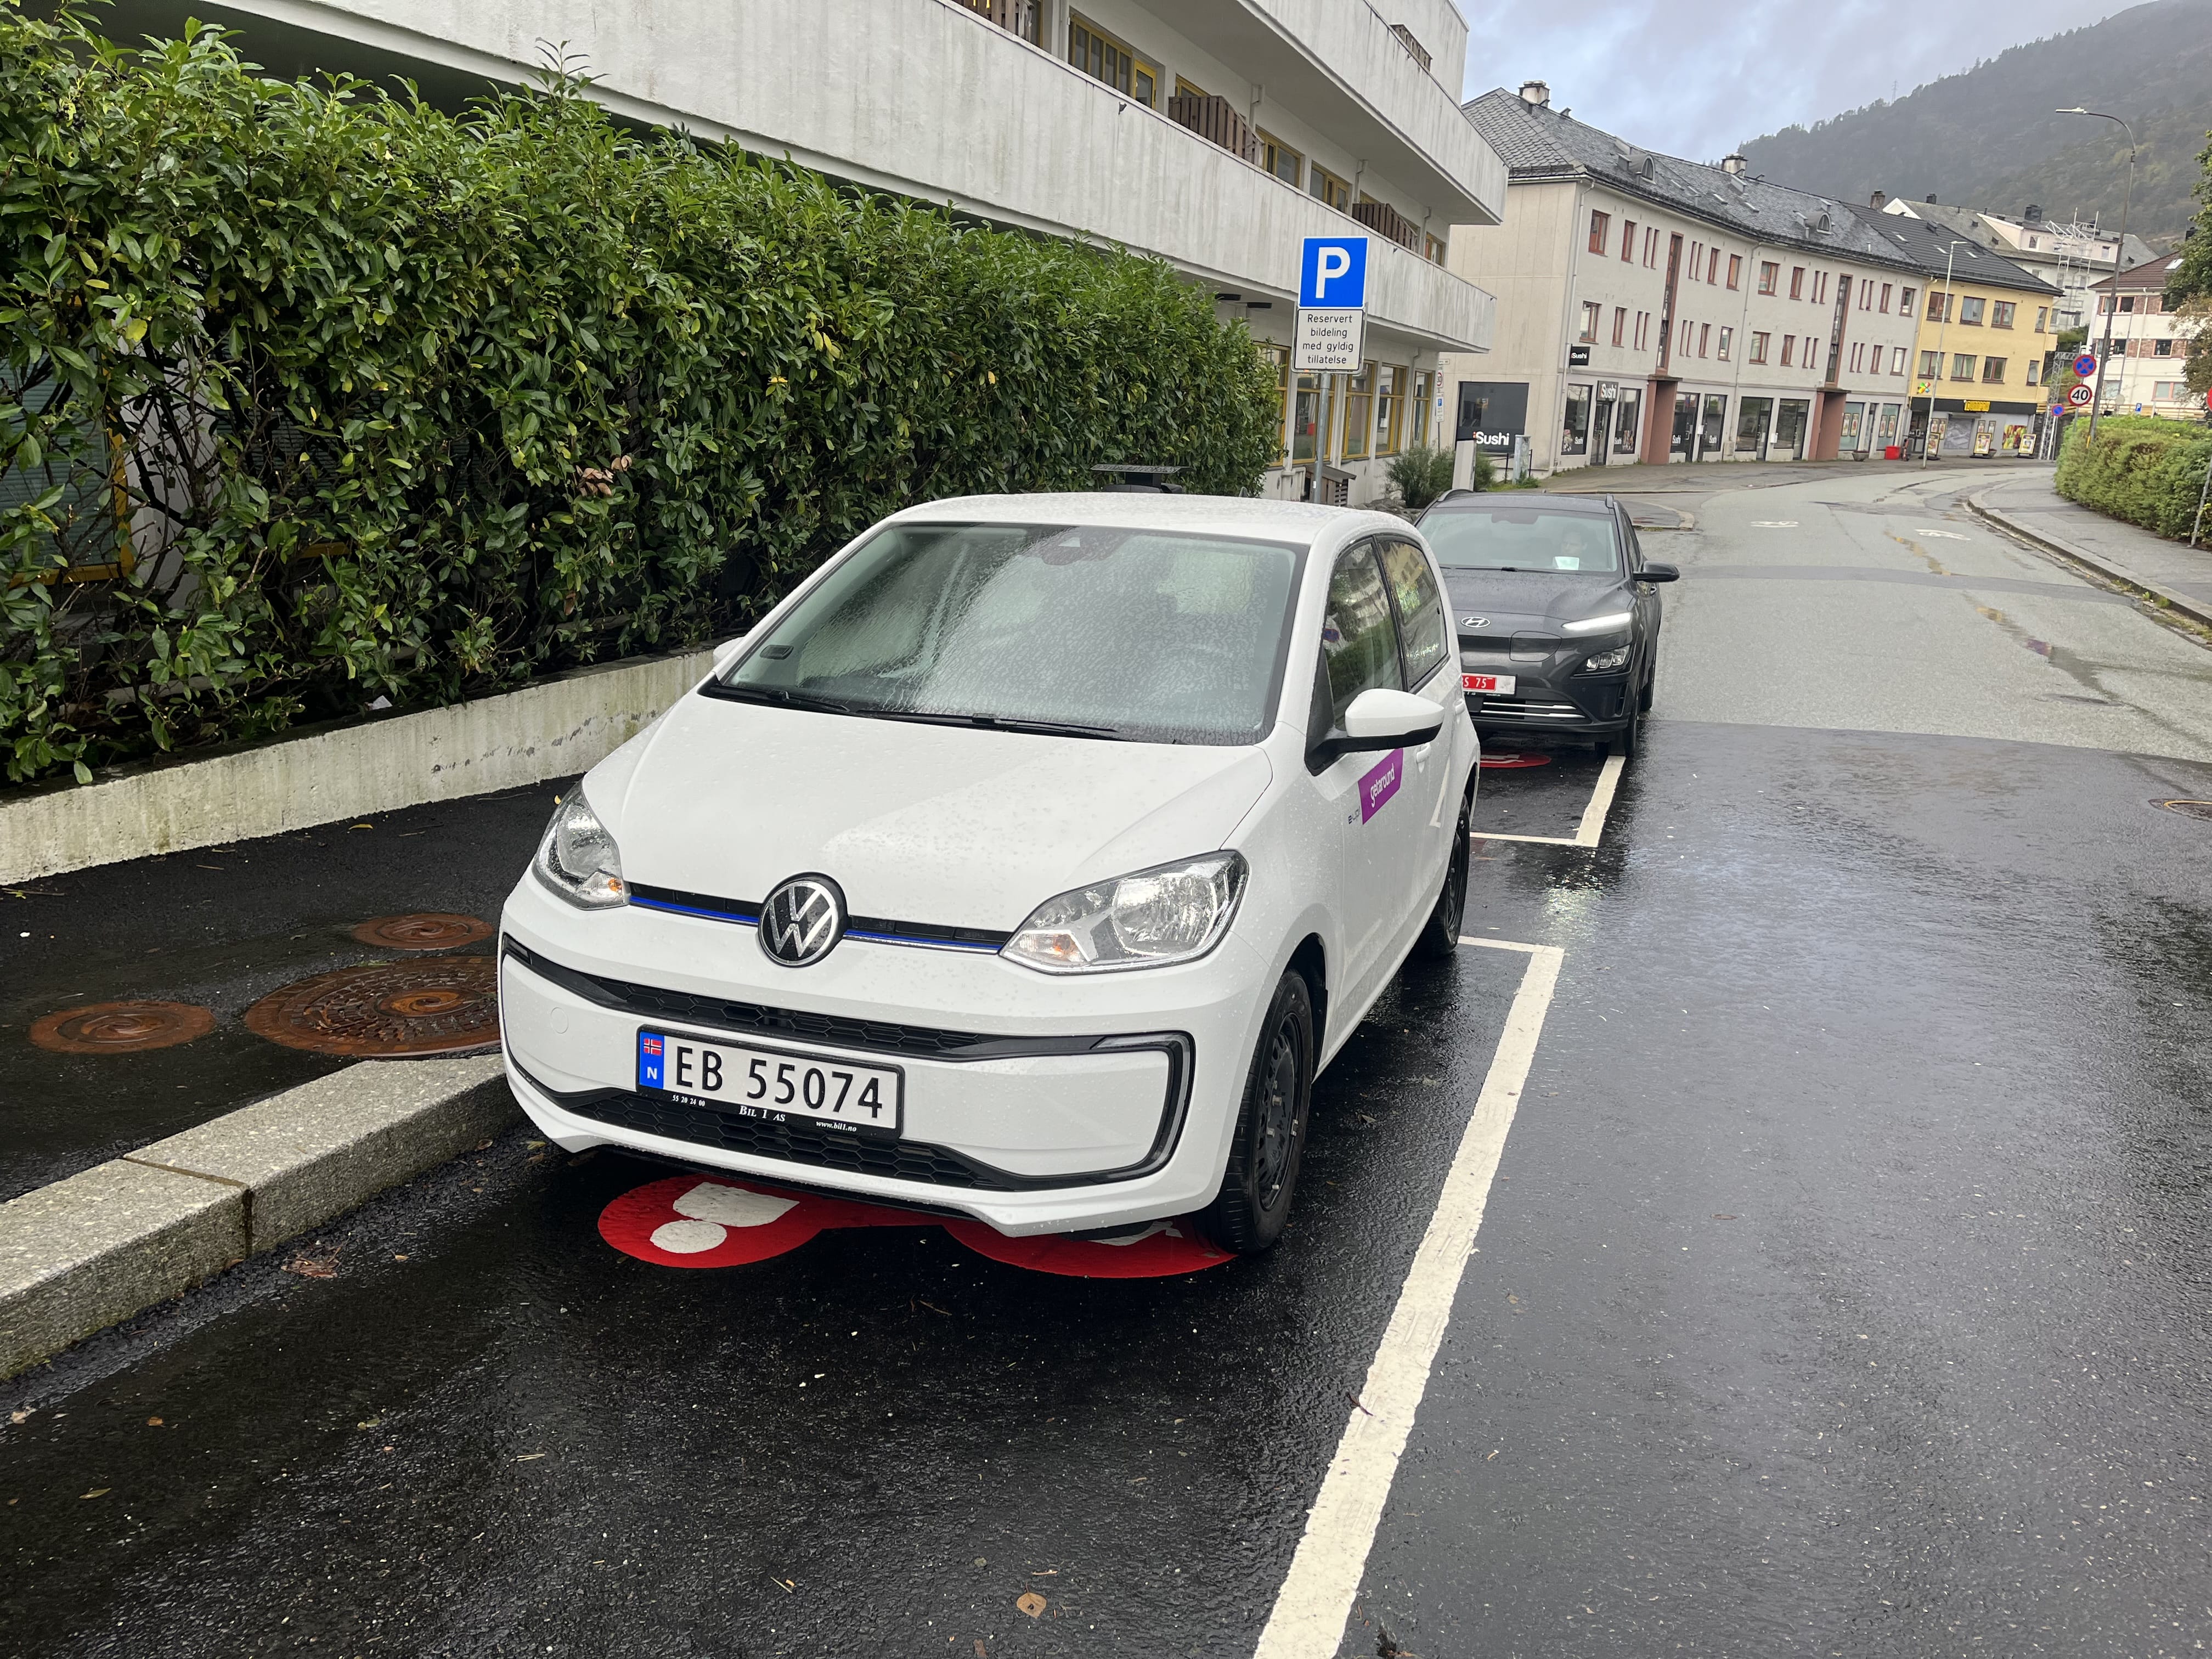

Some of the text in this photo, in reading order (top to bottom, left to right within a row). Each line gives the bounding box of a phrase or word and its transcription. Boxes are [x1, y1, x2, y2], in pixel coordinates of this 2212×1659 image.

[1315, 246, 1351, 298] P
[1307, 314, 1352, 323] Reservert
[1311, 328, 1347, 338] bildeling
[1302, 341, 1353, 352] med gyldig
[1307, 356, 1346, 364] tillatelse
[2072, 390, 2089, 400] 40
[1462, 676, 1469, 687] S
[1370, 763, 1395, 808] getaround
[646, 1066, 657, 1080] N
[676, 1046, 883, 1118] EB 55074
[762, 1109, 768, 1119] 1
[773, 1113, 786, 1122] AS
[816, 1121, 857, 1132] www.bil1.no
